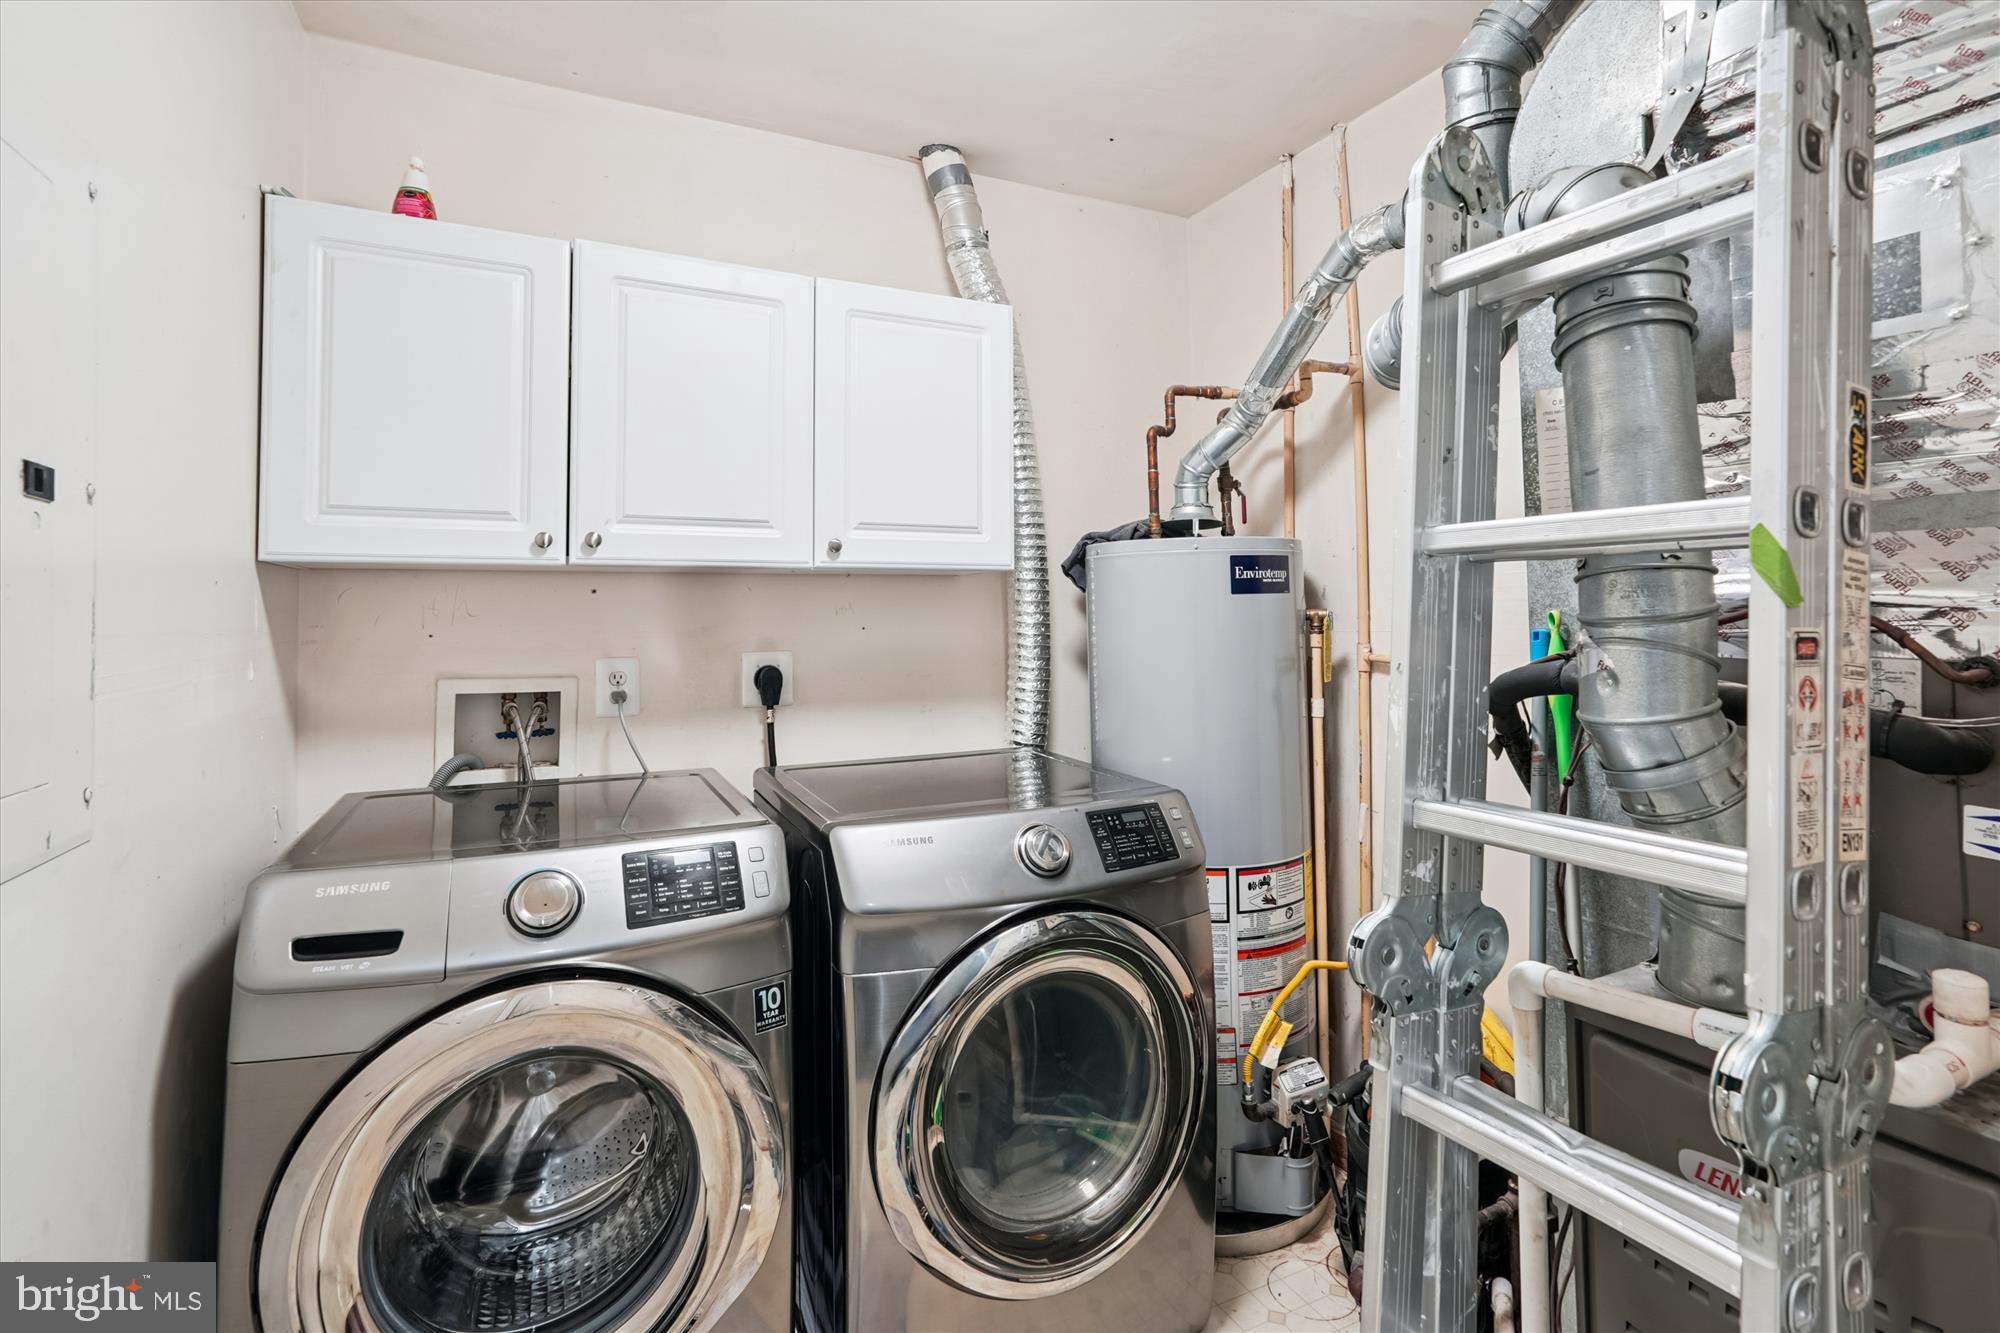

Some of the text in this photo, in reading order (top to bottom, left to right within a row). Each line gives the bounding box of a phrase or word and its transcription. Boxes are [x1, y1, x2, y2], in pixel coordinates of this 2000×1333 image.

[1851, 393, 1866, 481] SARK
[1235, 566, 1287, 582] Envirotemp
[315, 881, 391, 898] SAMSUNG
[758, 986, 782, 1012] 10
[757, 1015, 786, 1027] WARRANTY
[763, 1009, 779, 1019] YEAR
[1694, 1161, 1742, 1200] LEN
